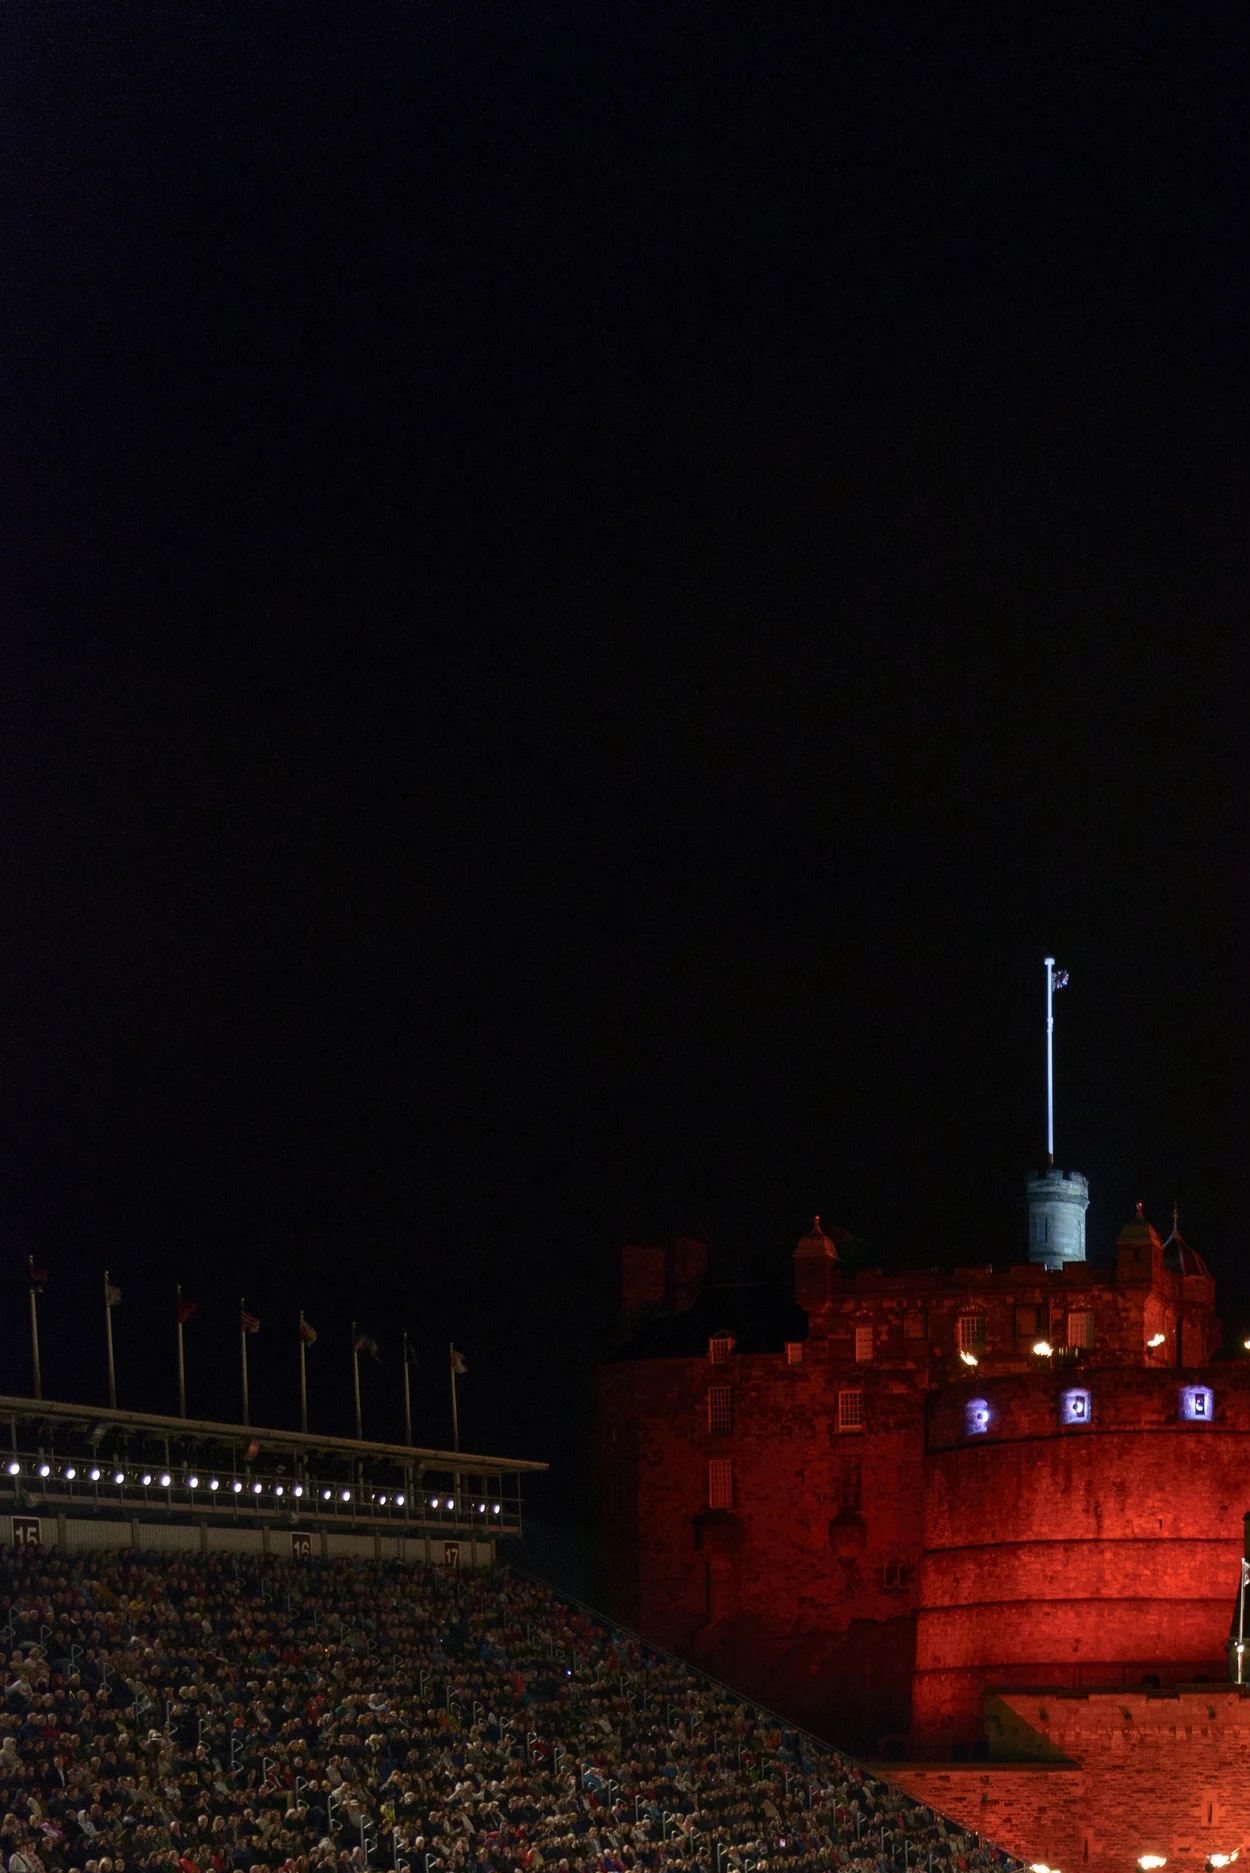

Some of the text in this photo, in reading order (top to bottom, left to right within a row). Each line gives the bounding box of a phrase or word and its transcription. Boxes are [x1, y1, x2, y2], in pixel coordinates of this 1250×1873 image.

[15, 1526, 38, 1545] 15
[293, 1540, 310, 1558] 16
[445, 1548, 459, 1569] 17
